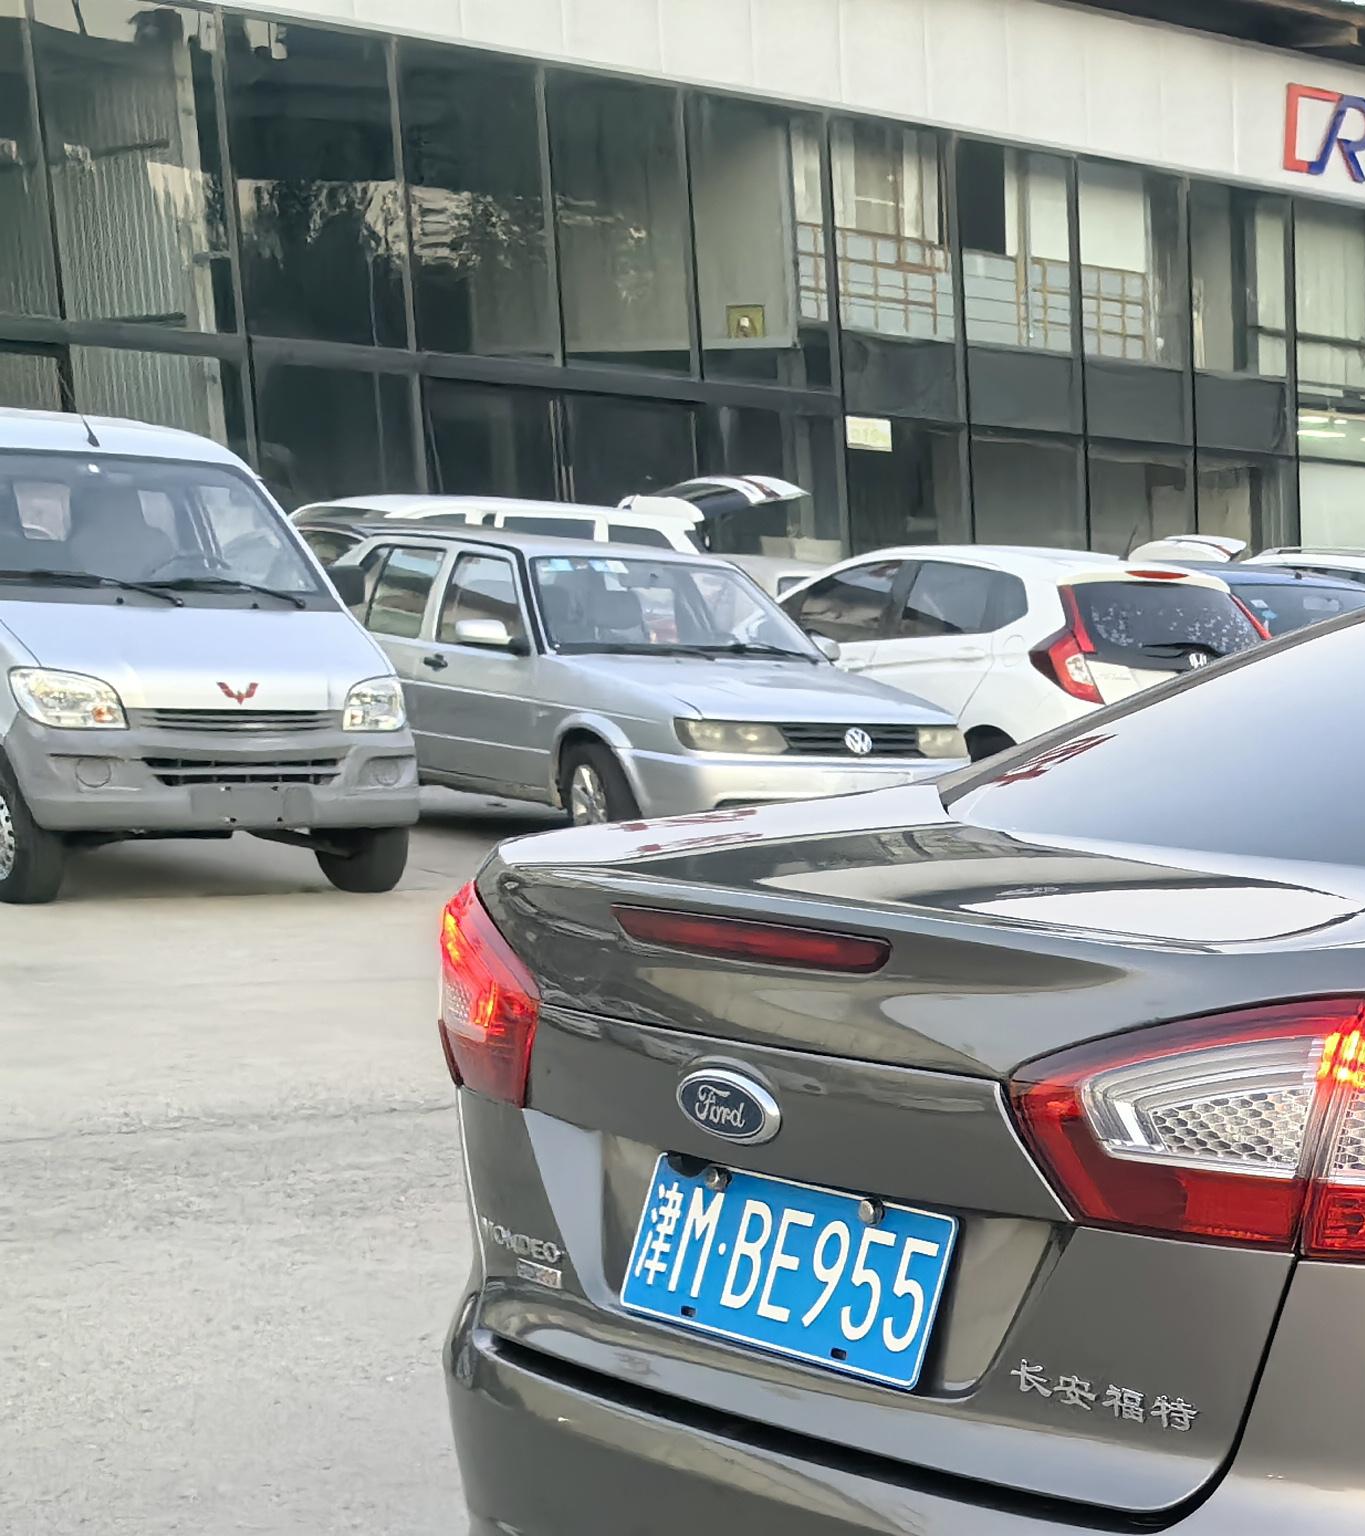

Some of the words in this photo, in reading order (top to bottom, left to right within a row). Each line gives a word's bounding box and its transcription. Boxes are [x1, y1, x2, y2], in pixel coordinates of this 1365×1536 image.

[694, 1084, 746, 1129] Ford
[634, 1181, 940, 1353] 津M·BE955
[1010, 1358, 1200, 1433] 长安福特
